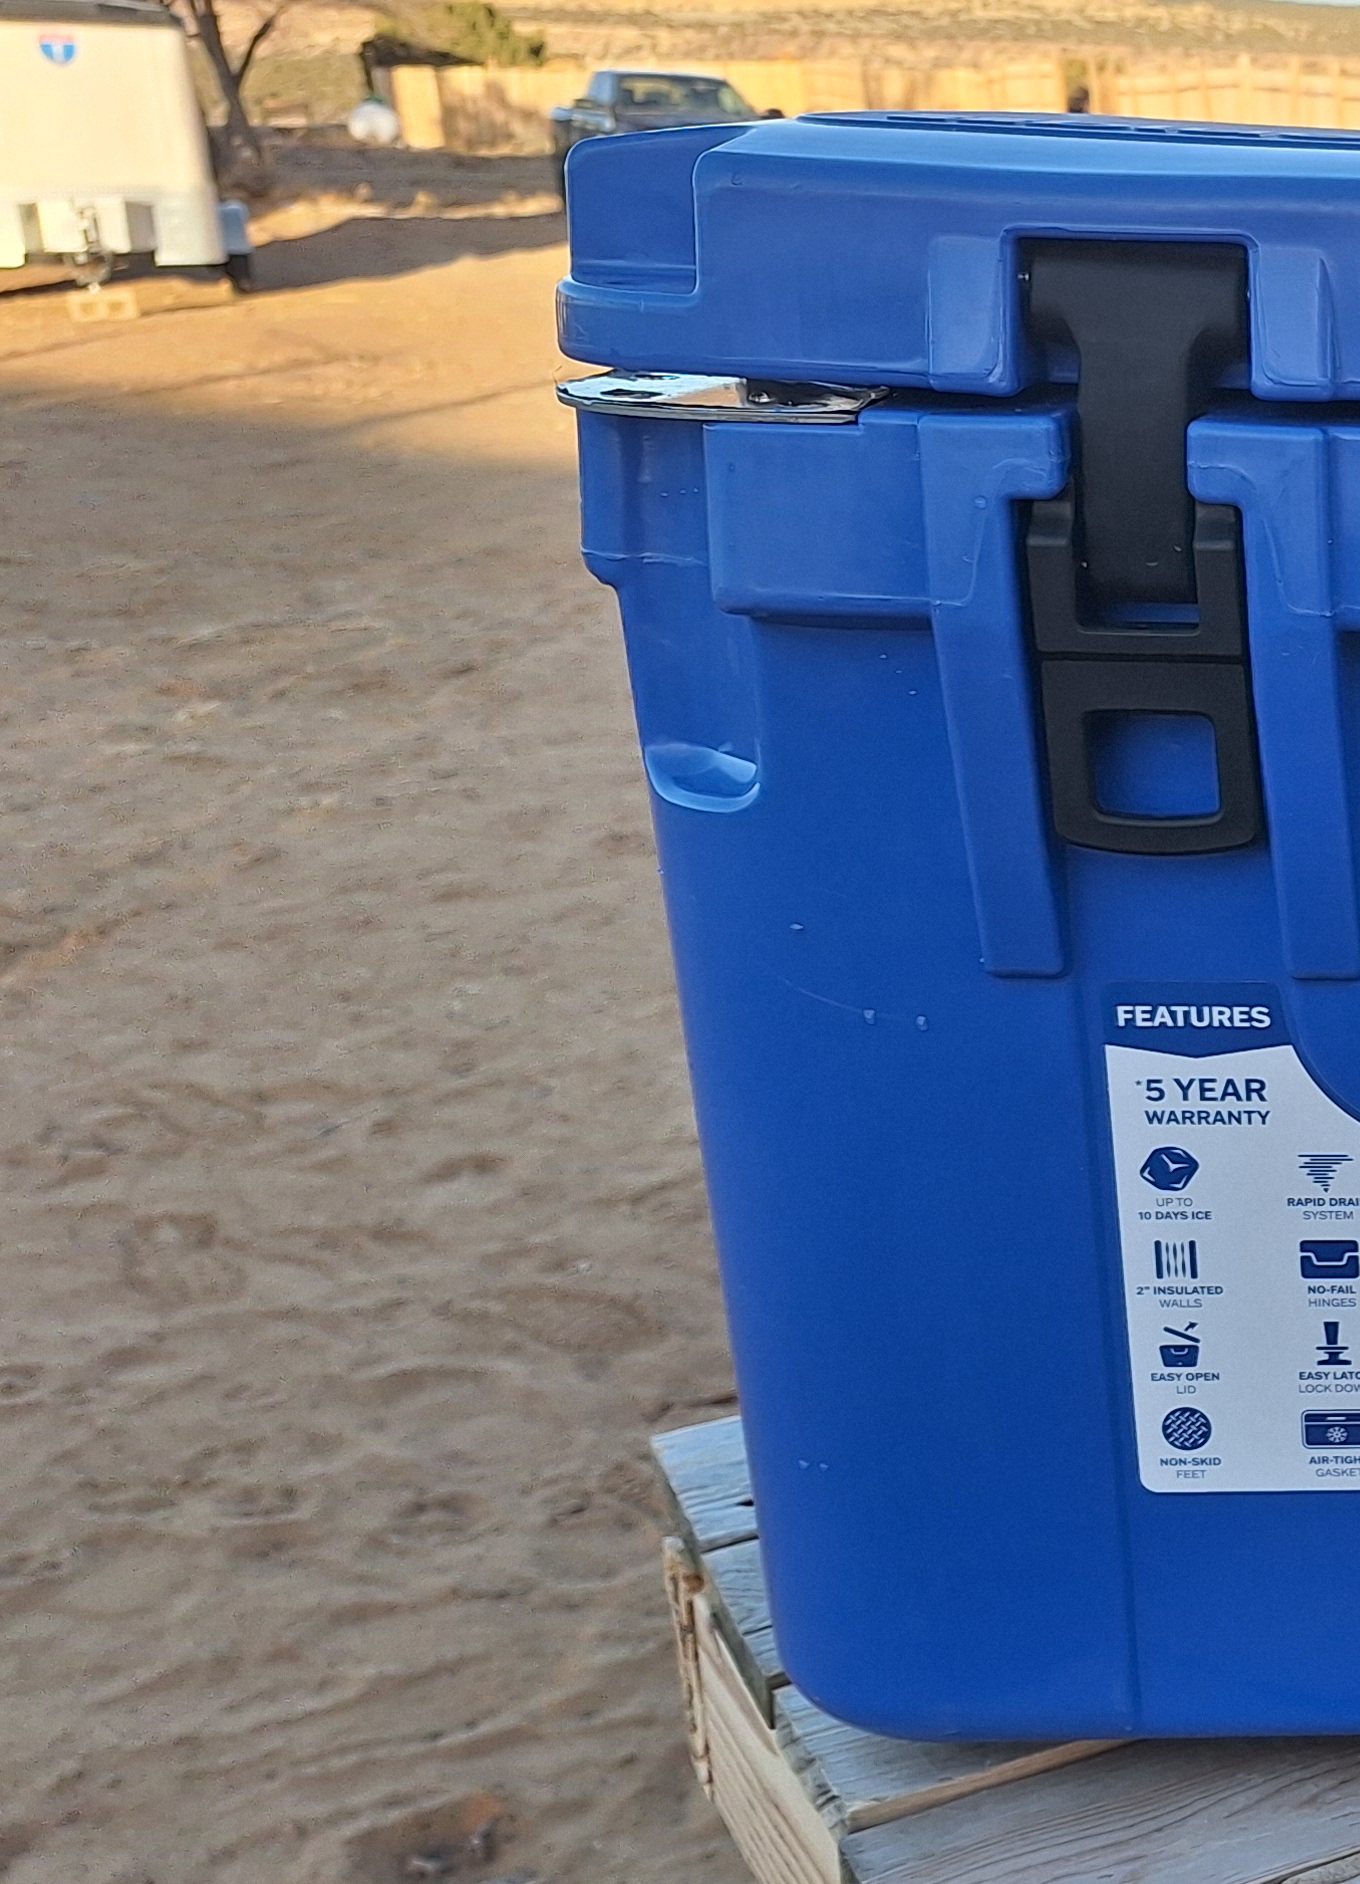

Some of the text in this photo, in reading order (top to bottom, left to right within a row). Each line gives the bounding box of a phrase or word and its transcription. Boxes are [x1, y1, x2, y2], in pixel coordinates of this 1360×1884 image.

[1116, 1005, 1271, 1028] FEATURES
[1173, 1078, 1267, 1102] YEAR
[1144, 1110, 1271, 1126] WARRANTY
[1155, 1197, 1194, 1207] UP TO
[1287, 1197, 1326, 1207] RAPID
[1138, 1210, 1212, 1221] 10 DAYS ICE
[1302, 1210, 1354, 1220] SYSTEM
[1153, 1285, 1224, 1295] INSULATED
[1307, 1285, 1357, 1295] NO-FAIL
[1158, 1298, 1203, 1309] WALLS
[1308, 1297, 1357, 1308] HINGES
[1150, 1372, 1220, 1382] EASY OPEN
[1298, 1371, 1331, 1381] EASY
[1176, 1384, 1197, 1395] LID
[1298, 1383, 1333, 1394] LOCK
[1159, 1457, 1222, 1467] NON-SKID
[1176, 1469, 1207, 1479] FEET
